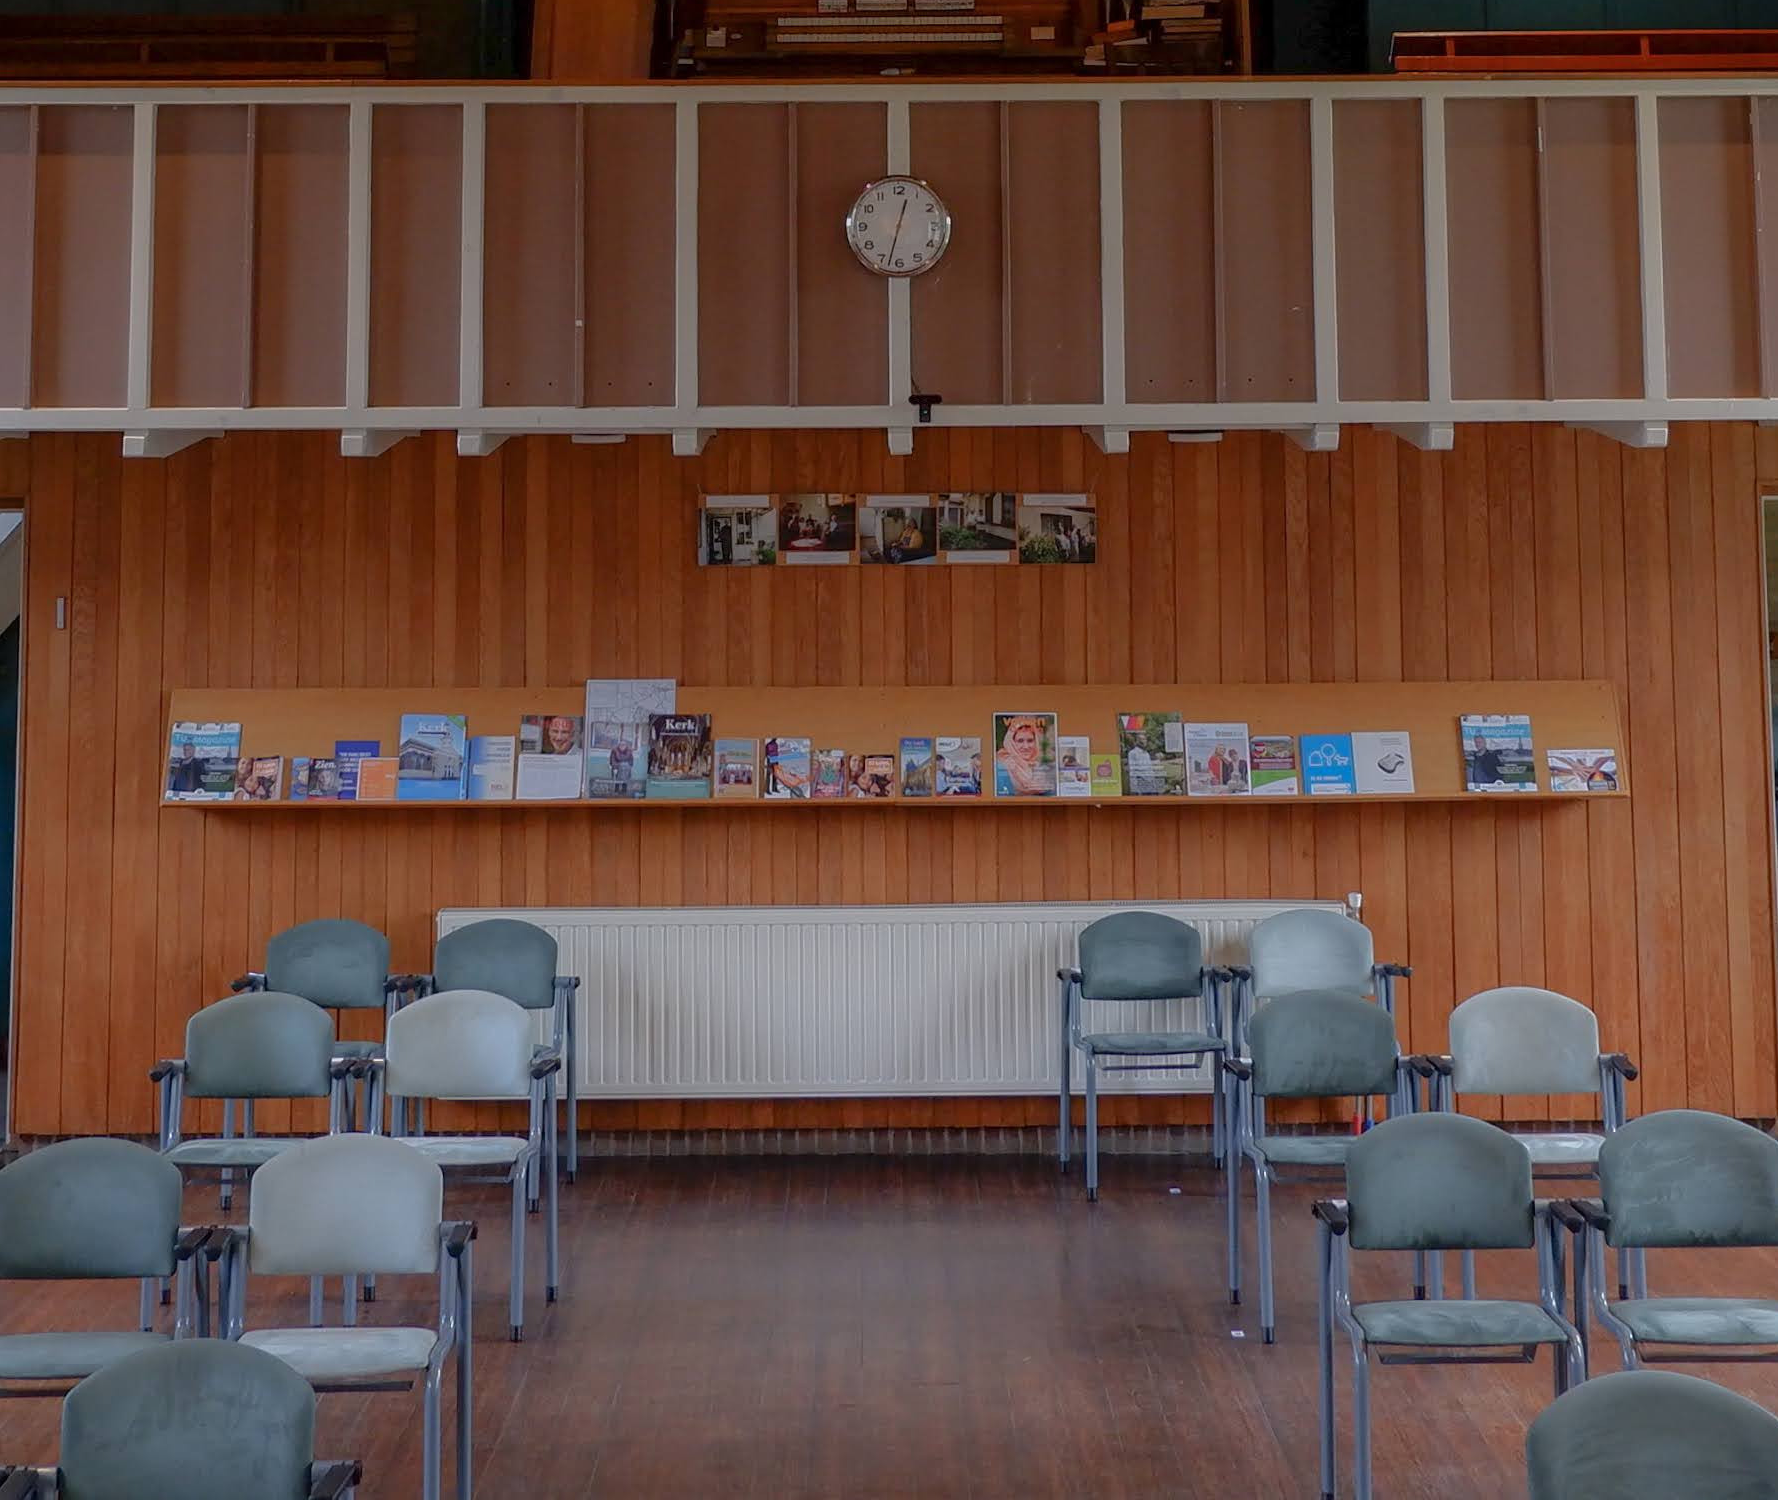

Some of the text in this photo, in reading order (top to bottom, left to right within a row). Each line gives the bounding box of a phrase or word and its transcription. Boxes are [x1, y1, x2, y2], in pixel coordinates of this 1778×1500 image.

[893, 186, 905, 195] 12
[877, 192, 885, 201] 11
[864, 204, 874, 214] 10
[925, 203, 934, 212] 2
[858, 222, 868, 232] 9
[864, 240, 874, 250] 8
[926, 240, 934, 248] 4
[877, 254, 885, 263] 7
[913, 253, 922, 262] 5
[895, 258, 905, 268] 6
[665, 718, 696, 731] Kerk
